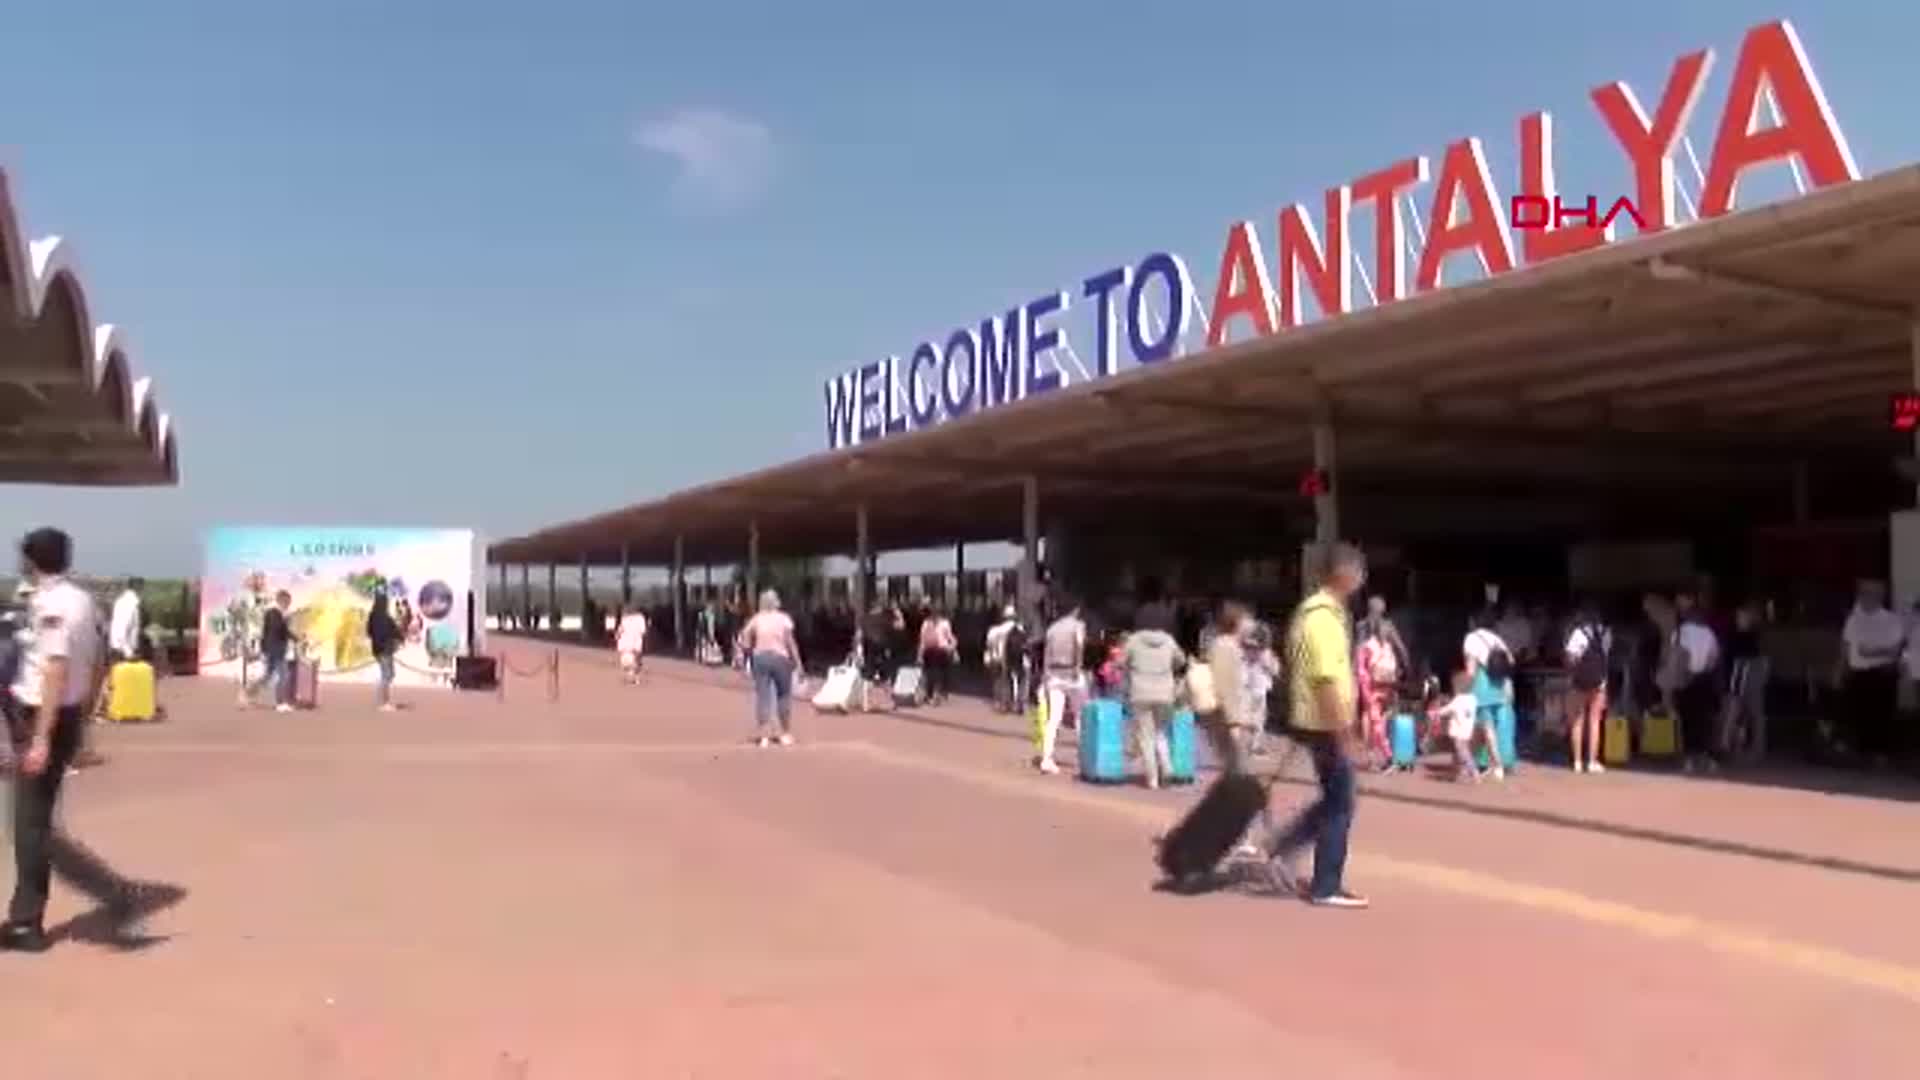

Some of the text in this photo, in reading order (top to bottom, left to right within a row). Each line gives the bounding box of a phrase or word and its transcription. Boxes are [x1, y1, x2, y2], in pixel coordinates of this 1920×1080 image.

[825, 20, 1860, 449] WELCOME TO ANTALYA
